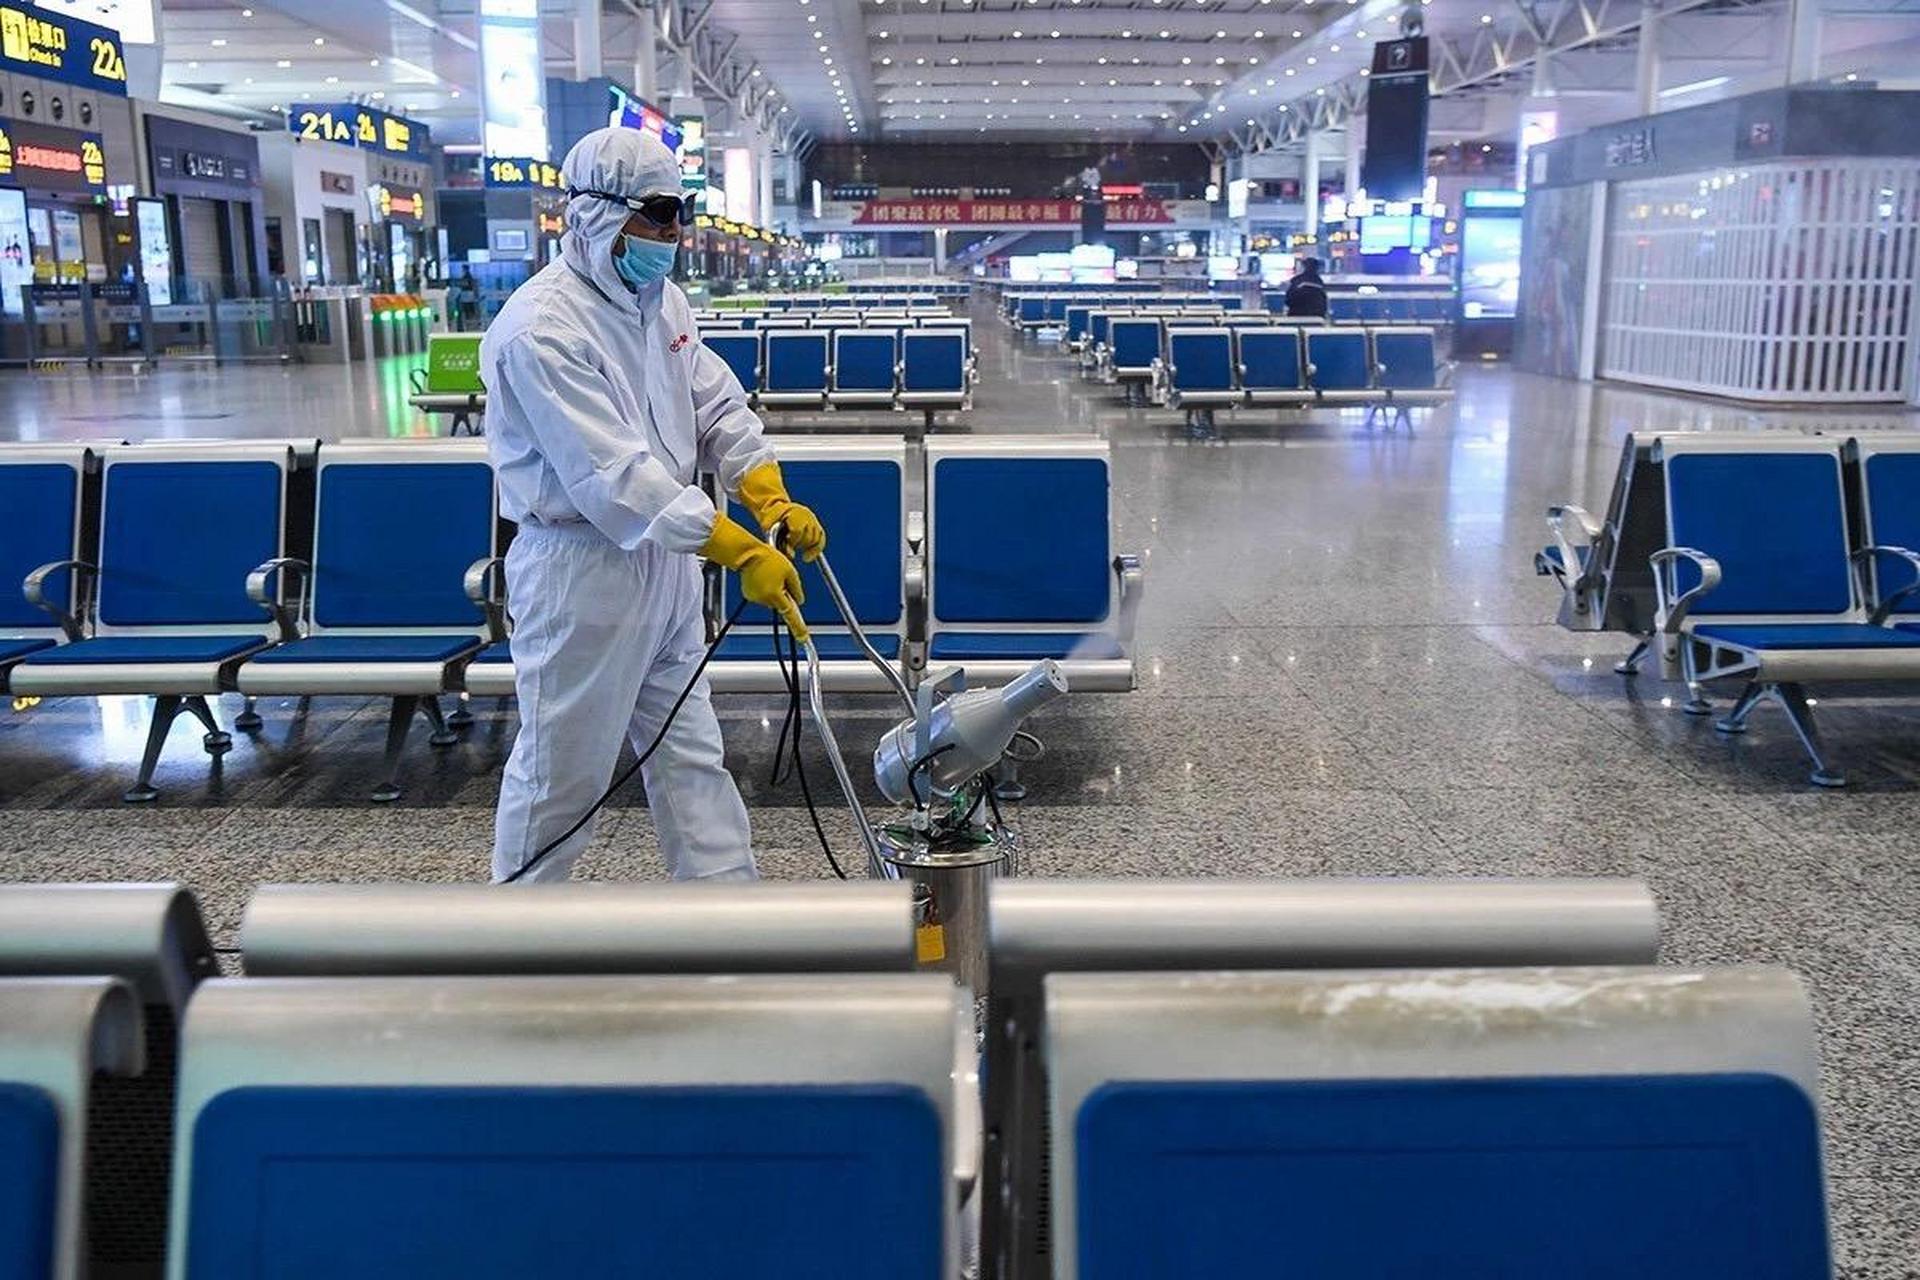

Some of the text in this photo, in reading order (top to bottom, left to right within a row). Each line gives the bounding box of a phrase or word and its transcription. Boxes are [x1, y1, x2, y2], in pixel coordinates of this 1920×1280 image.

[91, 38, 127, 81] 22A
[300, 112, 351, 140] 21A
[490, 161, 524, 182] 19A
[1070, 204, 1157, 221] 团最有力
